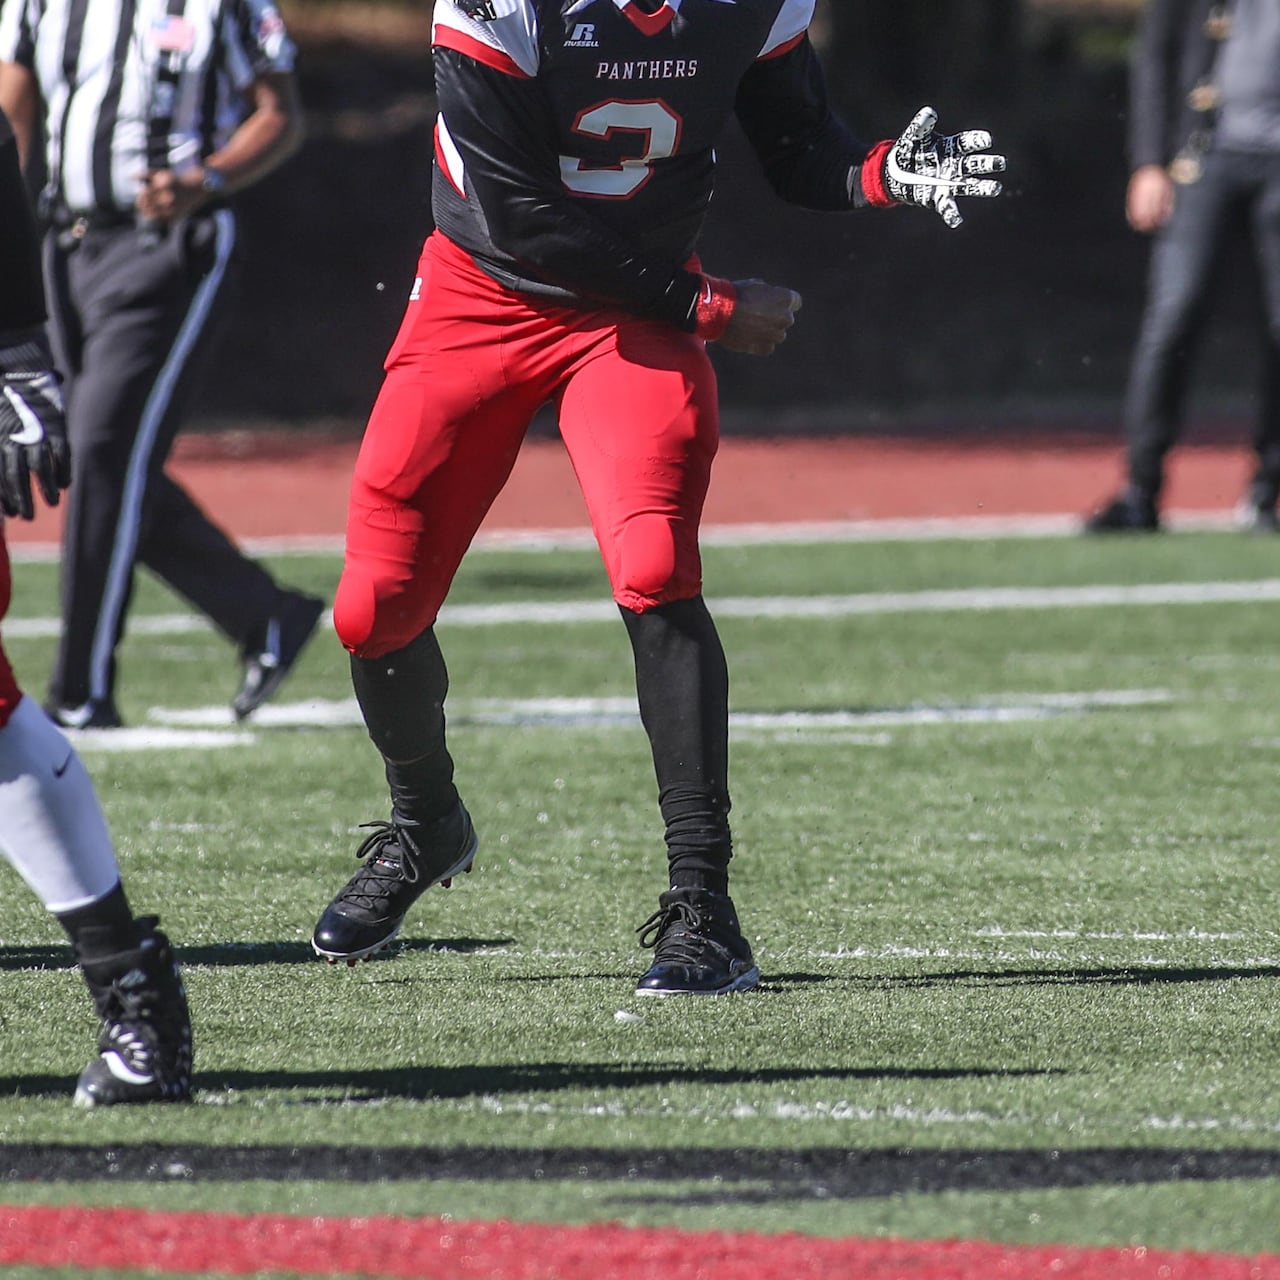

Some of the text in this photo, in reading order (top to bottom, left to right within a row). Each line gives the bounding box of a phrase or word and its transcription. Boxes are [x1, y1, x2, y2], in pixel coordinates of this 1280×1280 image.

[563, 39, 599, 48] RUSSELL
[596, 60, 698, 80] PANTHERS
[558, 97, 683, 200] 3
